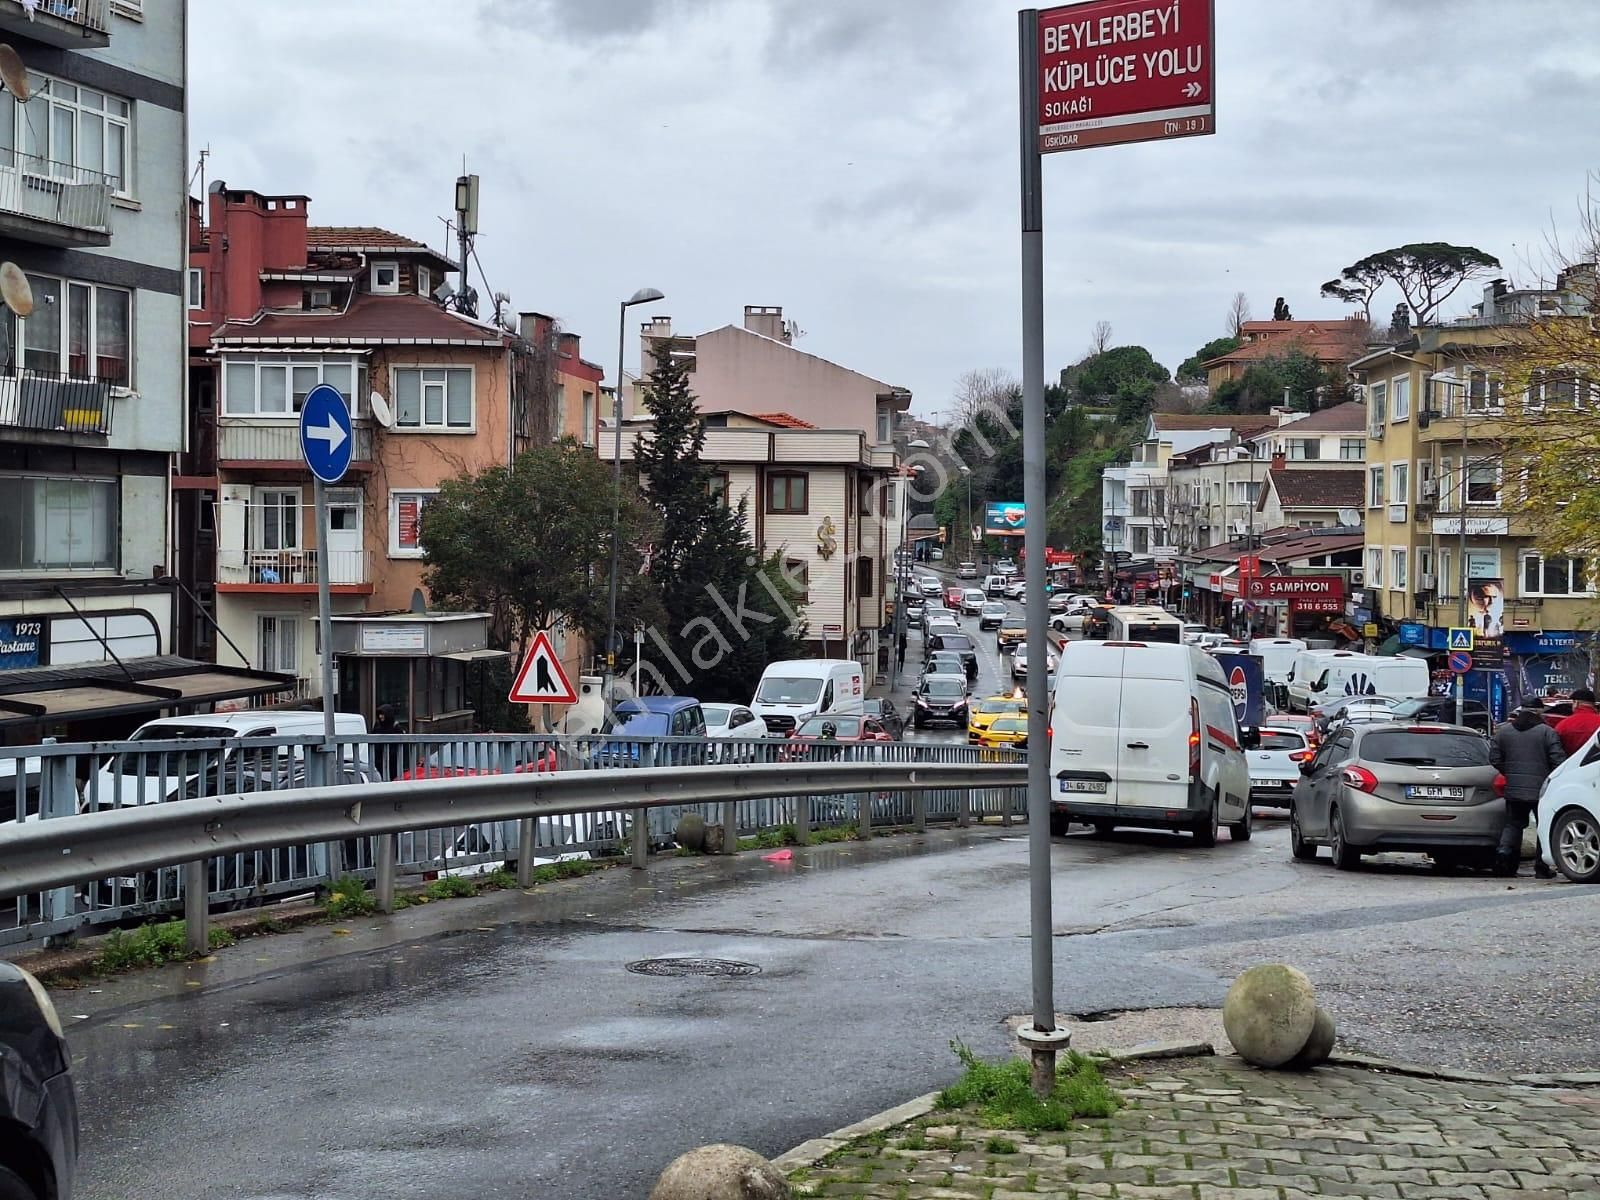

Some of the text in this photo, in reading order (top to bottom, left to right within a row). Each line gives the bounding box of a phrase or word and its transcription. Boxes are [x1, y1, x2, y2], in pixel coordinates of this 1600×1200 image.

[1044, 0, 1180, 54] BEYLERBEYİ
[1044, 45, 1202, 93] KÜPLÜCE YOLU
[1045, 96, 1092, 117] SOKAĞI
[1045, 134, 1078, 147] ÜSKÜDAR
[1269, 579, 1329, 596] ŞAMPİYON
[1322, 602, 1338, 611] 555
[15, 622, 41, 636] 1973
[1412, 786, 1422, 795] 34
